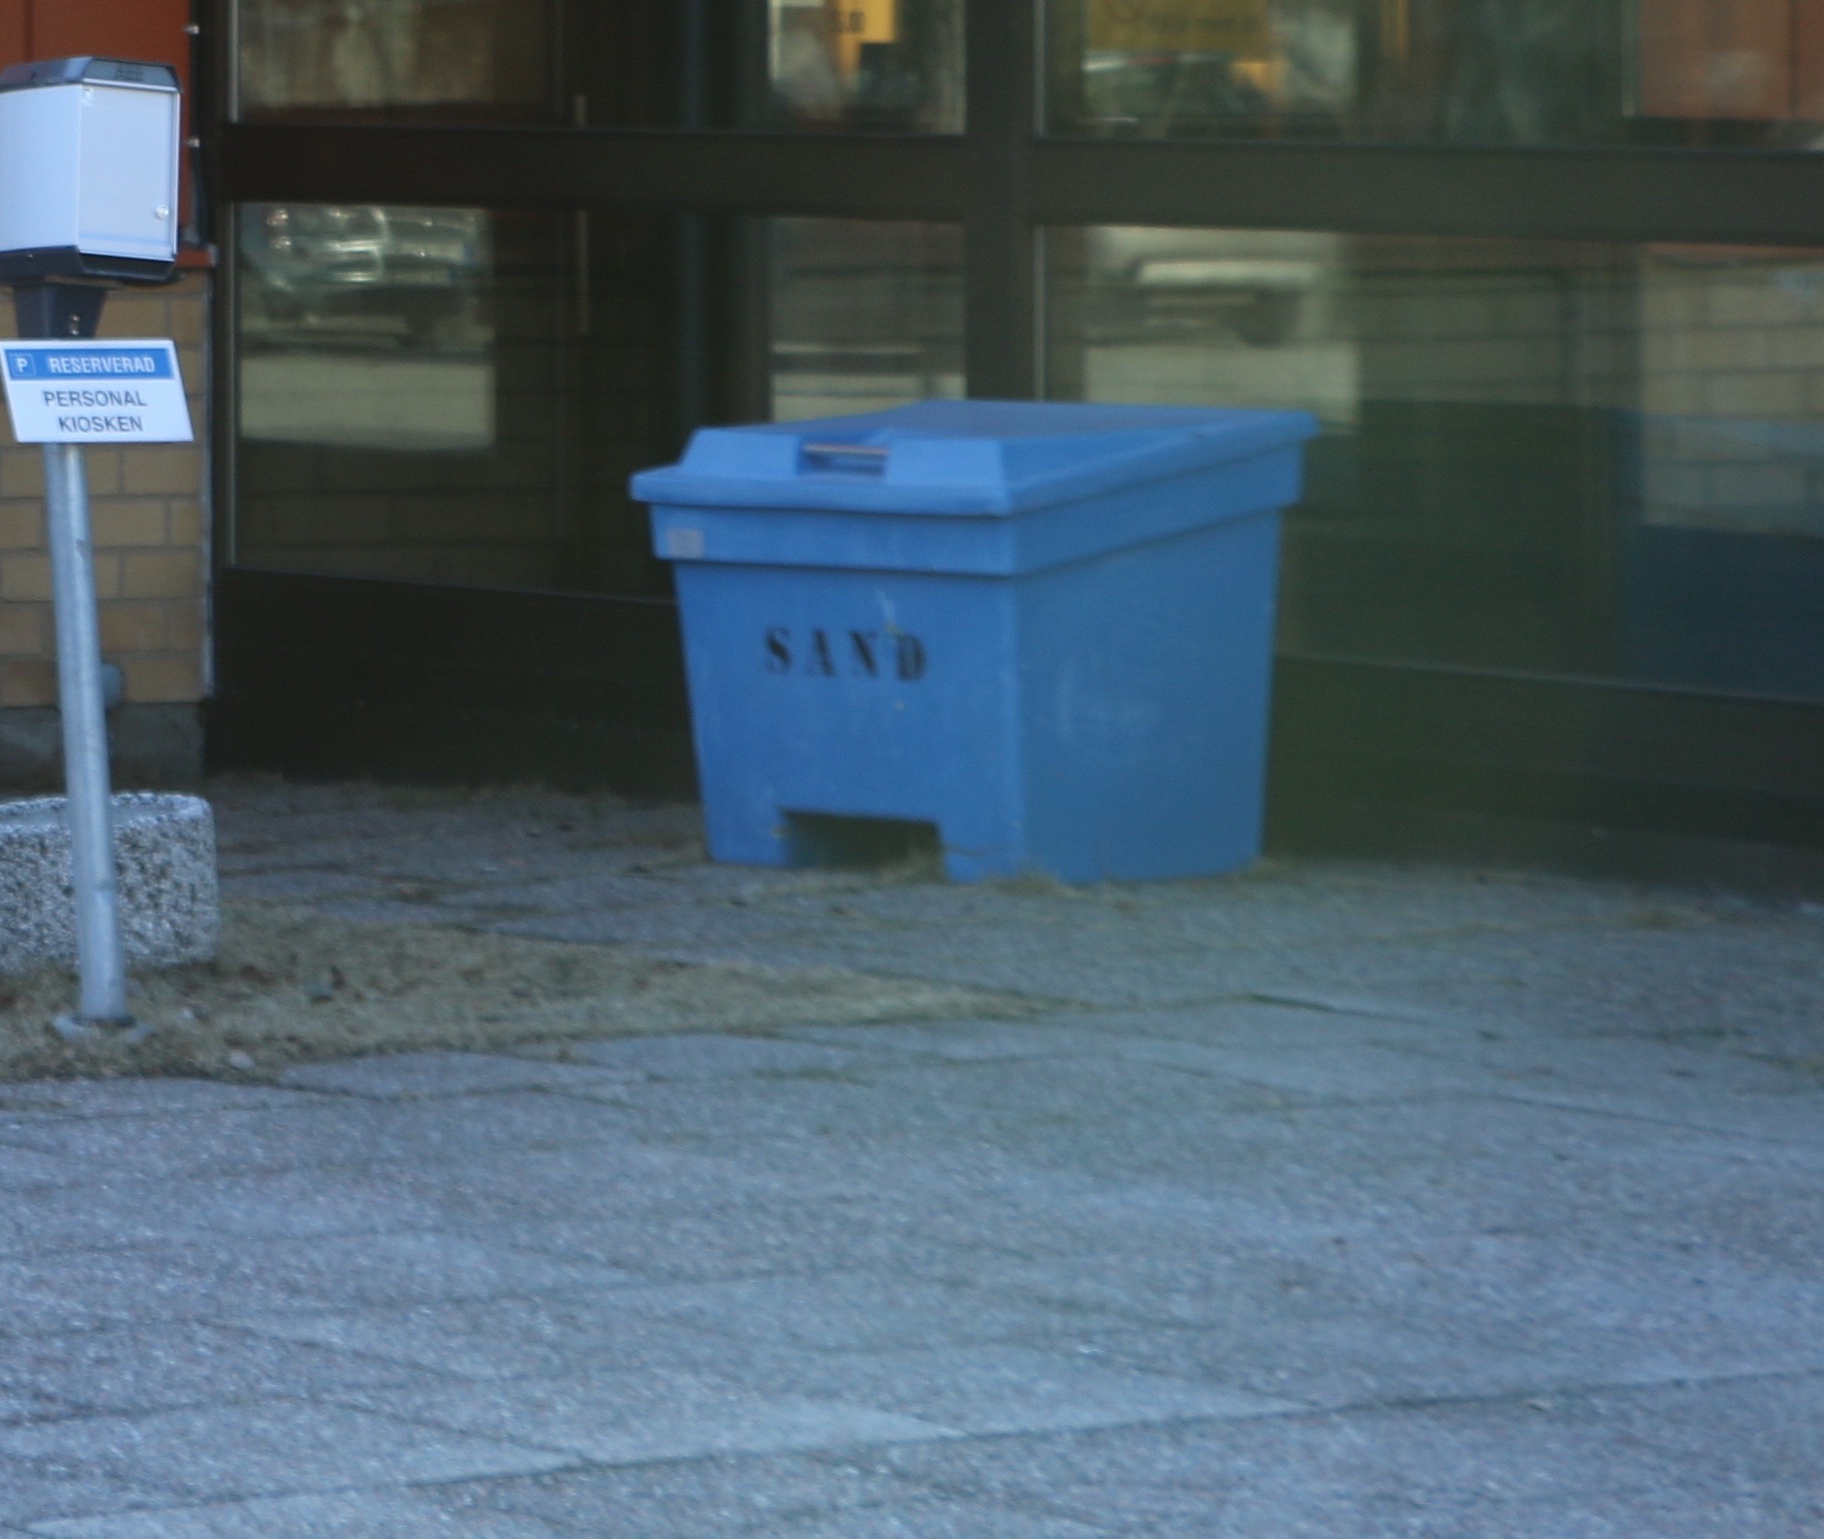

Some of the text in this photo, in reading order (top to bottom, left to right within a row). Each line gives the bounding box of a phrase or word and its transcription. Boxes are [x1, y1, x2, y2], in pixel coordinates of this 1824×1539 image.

[15, 356, 156, 374] P RESERVERAD
[43, 390, 149, 408] PERSONAL
[58, 415, 144, 433] KIOSKEN
[763, 626, 928, 682] SAND
